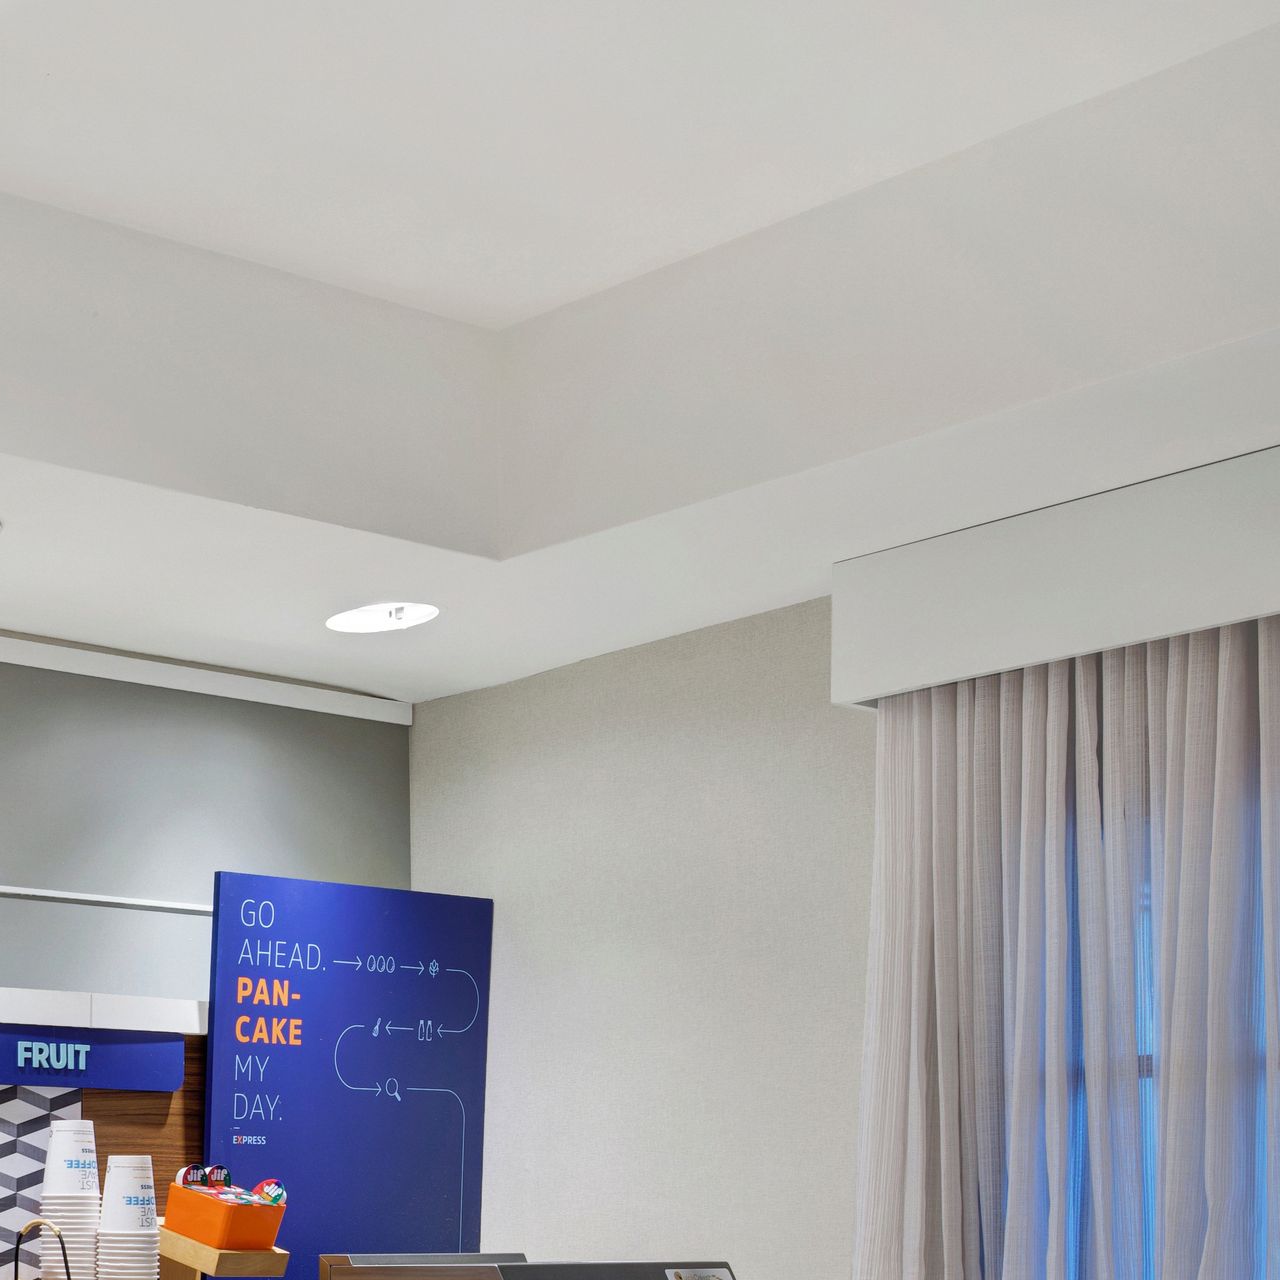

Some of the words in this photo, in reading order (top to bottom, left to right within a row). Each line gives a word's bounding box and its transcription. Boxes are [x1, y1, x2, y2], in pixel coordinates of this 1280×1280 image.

[241, 899, 275, 928] GO
[238, 938, 326, 971] AHEAD.
[237, 976, 301, 1007] PAN-
[235, 1015, 302, 1046] CAKE
[17, 1040, 91, 1070] FRUIT
[235, 1054, 270, 1082] MY
[234, 1093, 282, 1121] DAY.
[232, 1135, 267, 1145] EXPRESS
[187, 1168, 204, 1182] Jif
[211, 1168, 228, 1181] Jif
[263, 1183, 283, 1198] Jif
